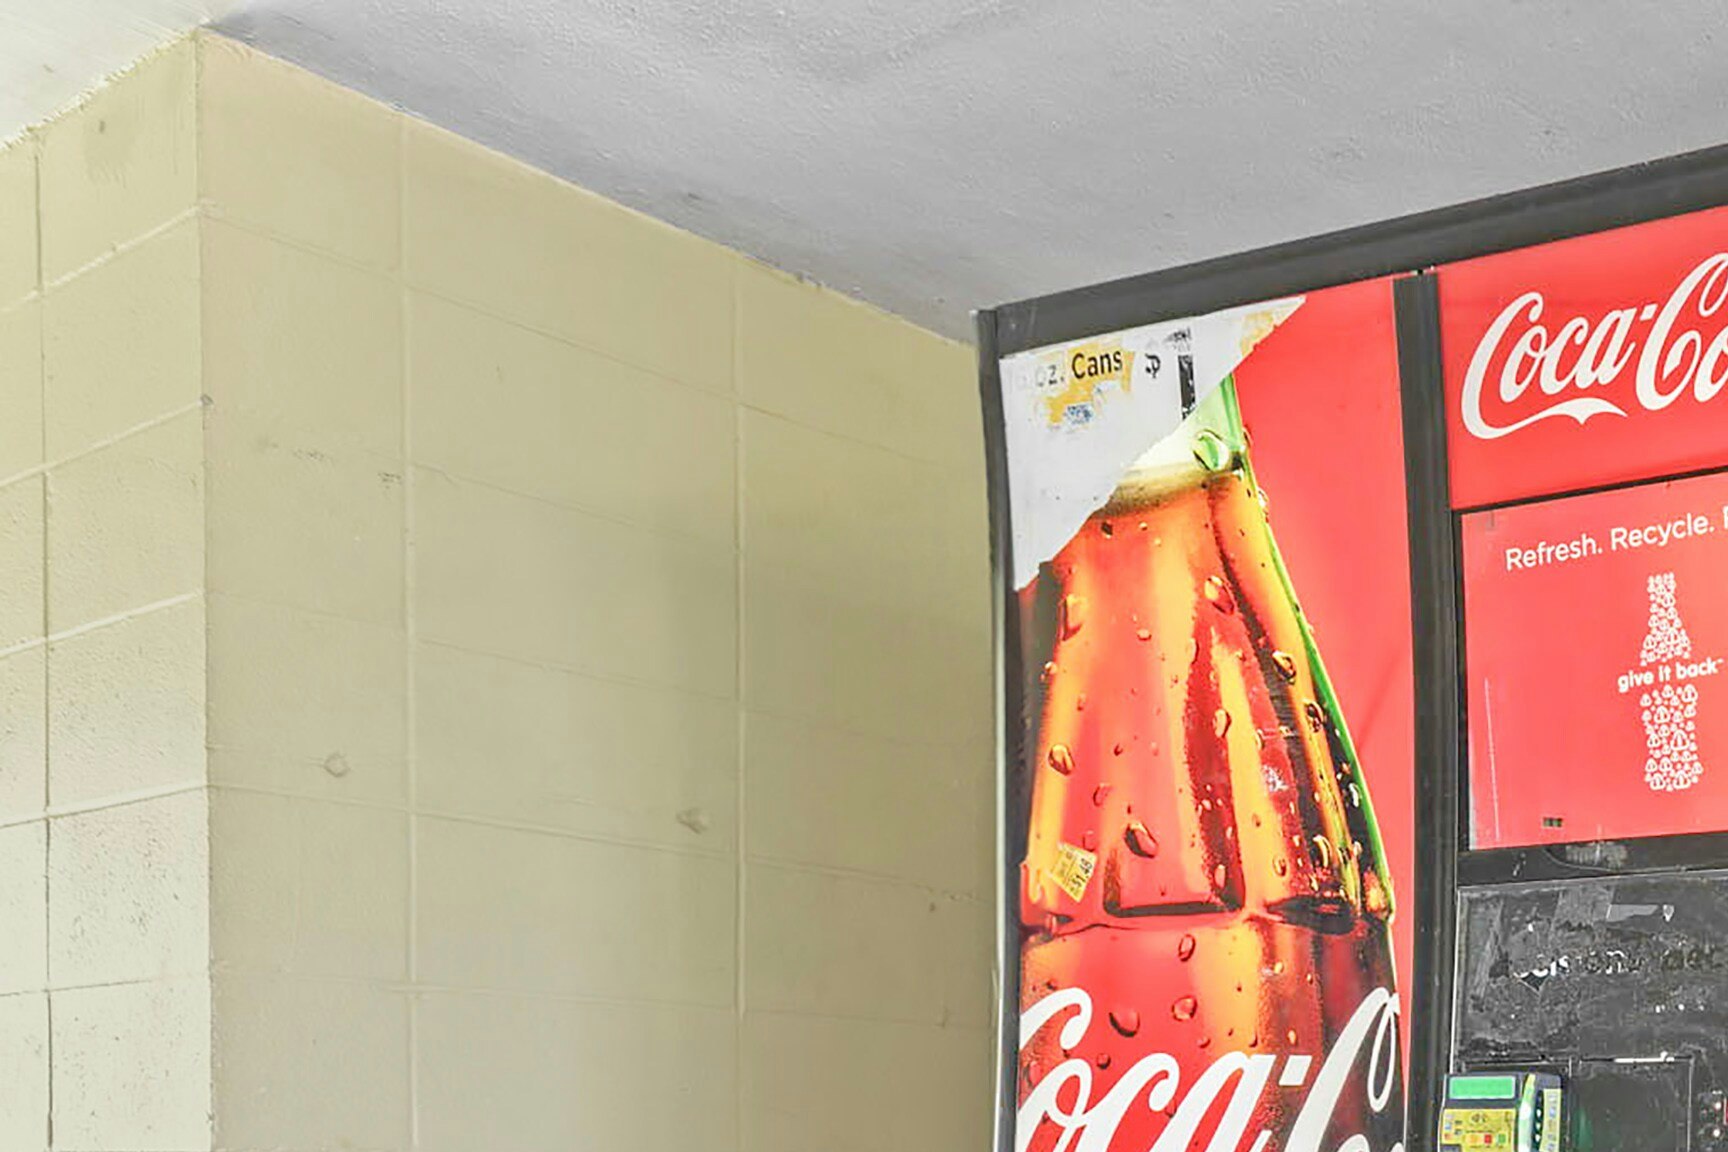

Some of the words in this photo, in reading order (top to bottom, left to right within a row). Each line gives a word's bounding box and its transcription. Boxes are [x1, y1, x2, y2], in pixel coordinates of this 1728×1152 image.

[1071, 350, 1123, 379] Cans
[1505, 533, 1602, 570] Refresh.
[1610, 513, 1714, 551] Recycle.
[1617, 669, 1654, 693] give
[1658, 664, 1671, 682] it
